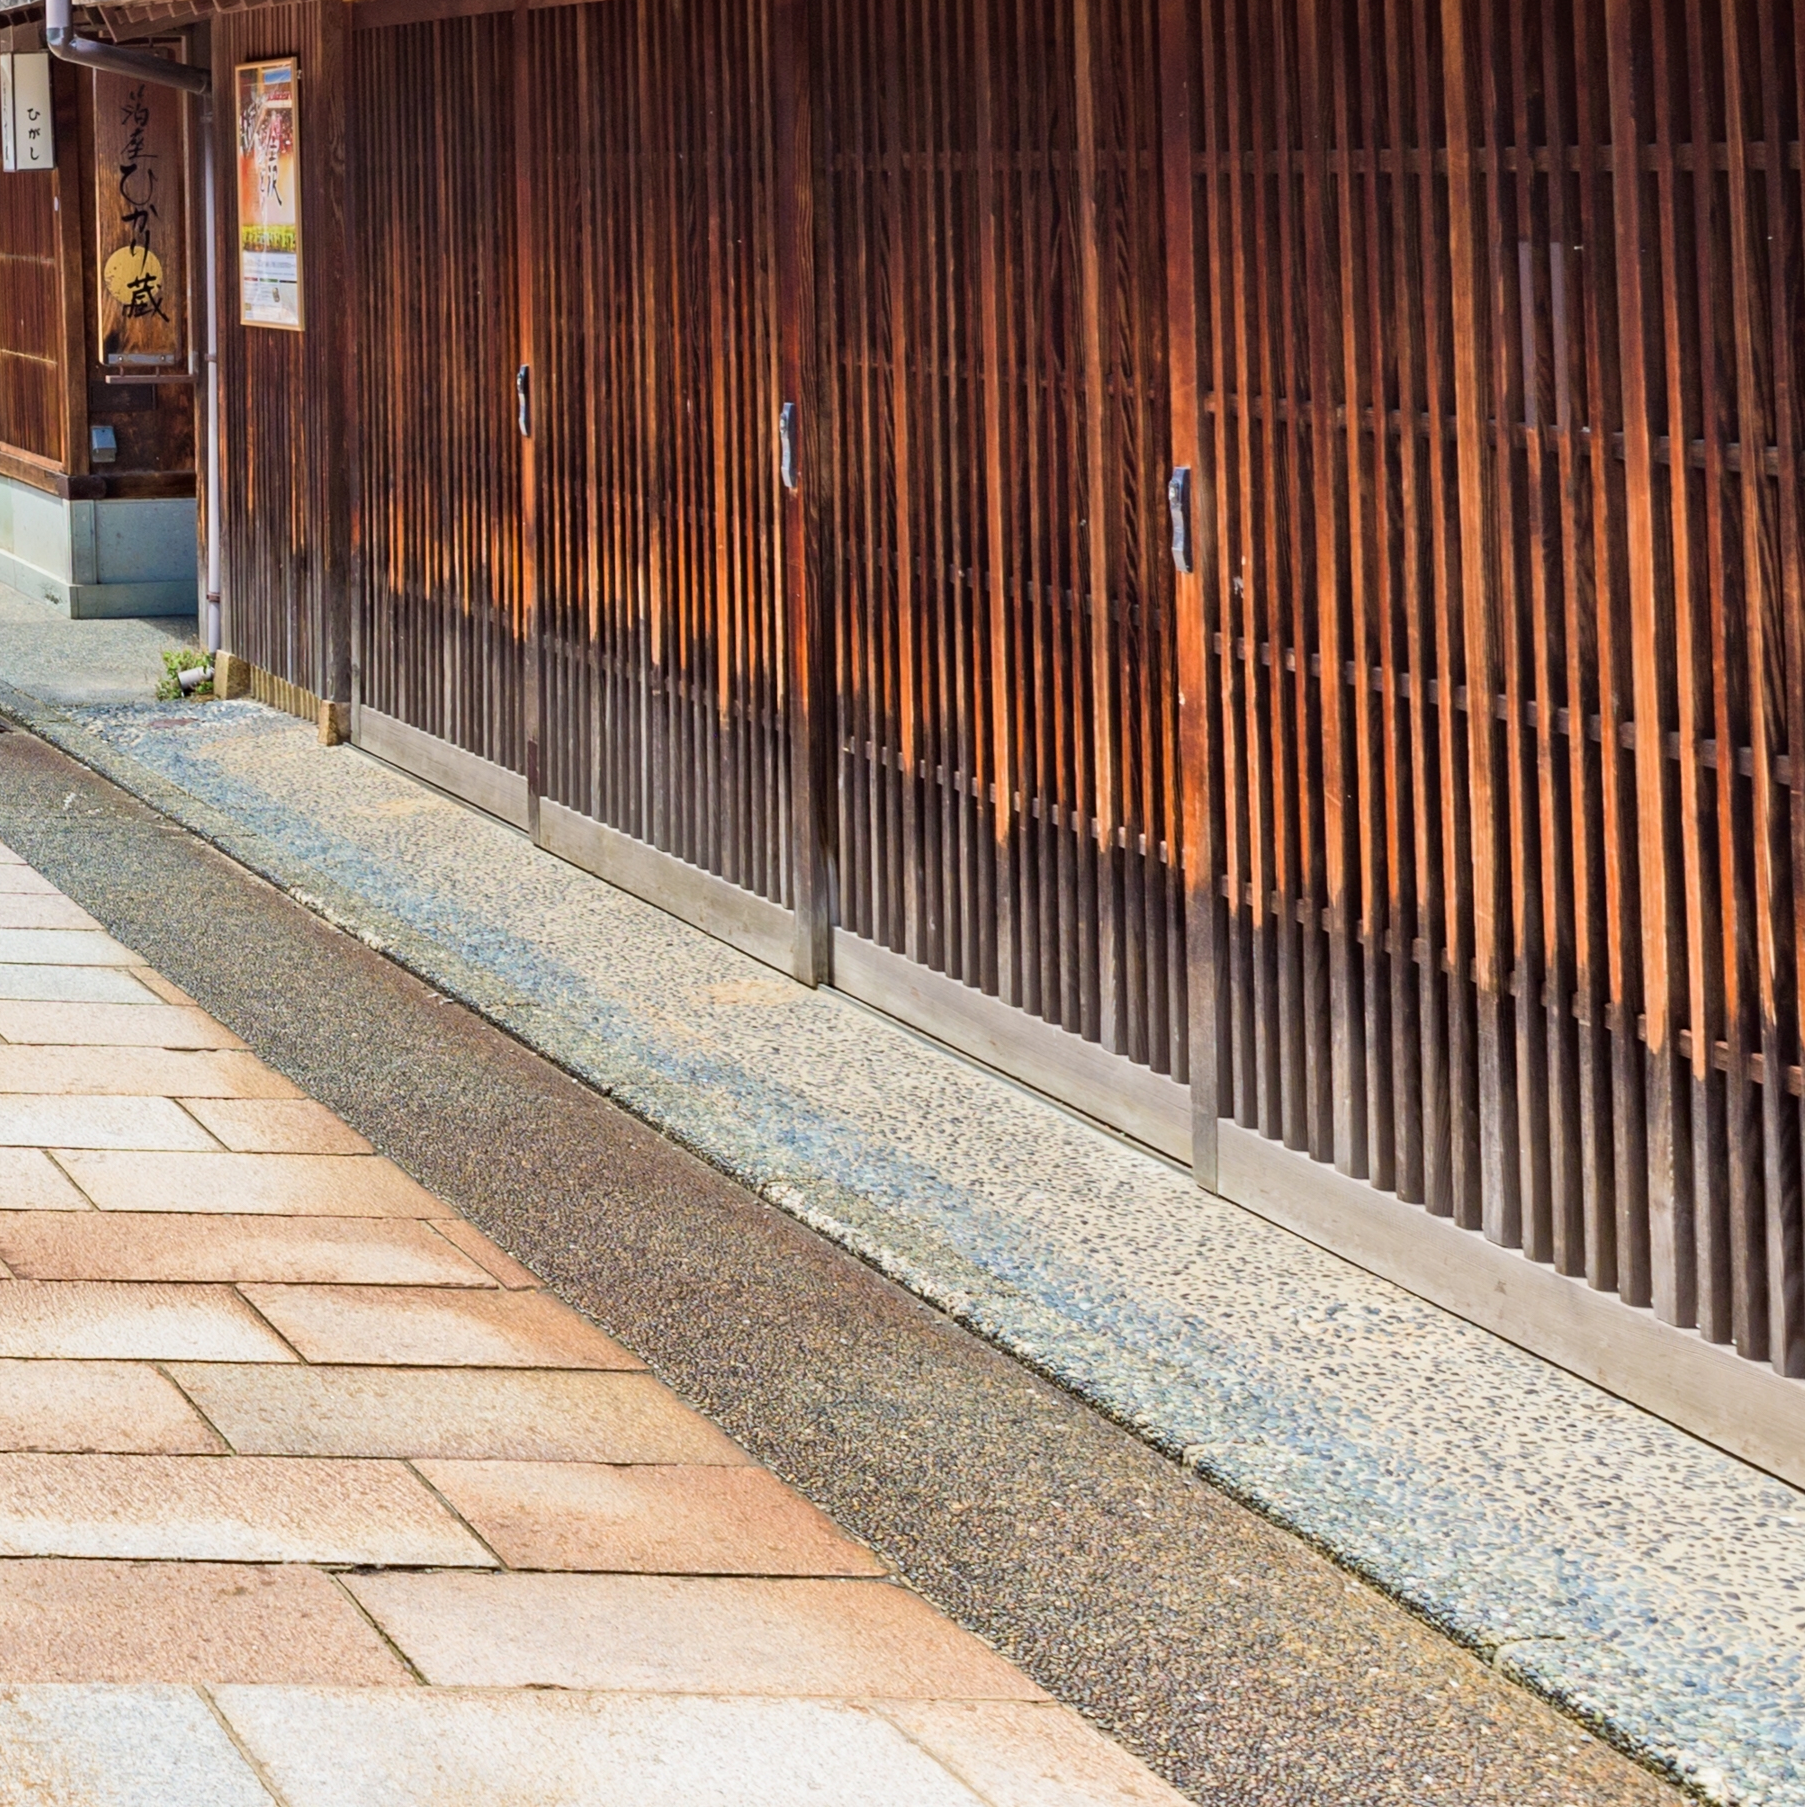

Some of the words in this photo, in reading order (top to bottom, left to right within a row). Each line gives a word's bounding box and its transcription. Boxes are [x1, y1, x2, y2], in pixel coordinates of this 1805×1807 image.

[27, 107, 41, 161] ひがし
[120, 84, 170, 323] 箔座ひかり蔵
